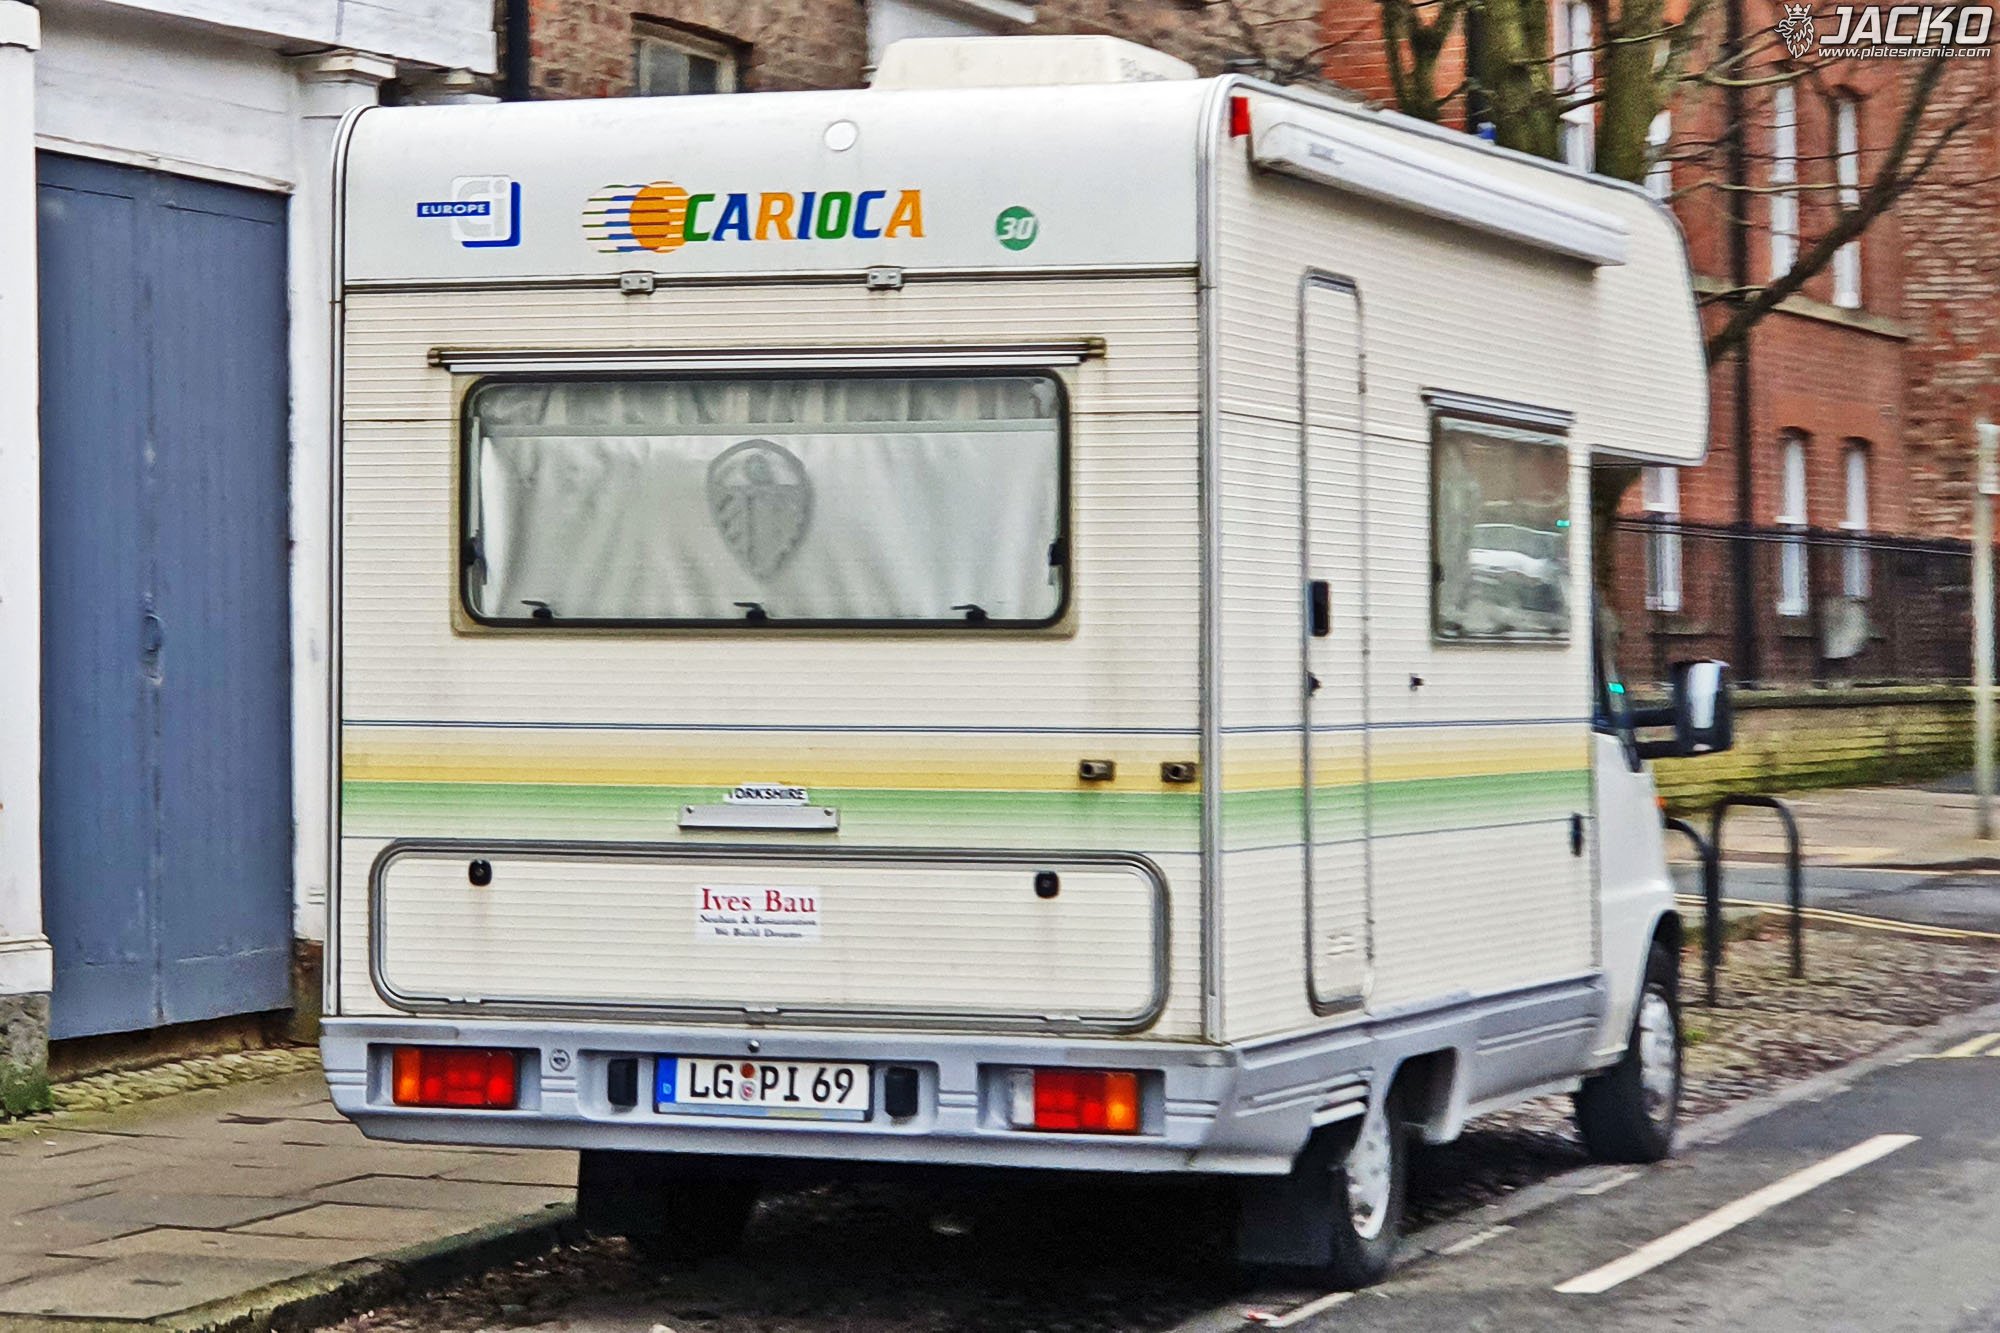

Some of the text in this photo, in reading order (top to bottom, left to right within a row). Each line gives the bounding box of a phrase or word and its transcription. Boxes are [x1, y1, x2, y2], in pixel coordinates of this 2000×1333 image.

[421, 203, 487, 215] EUROPE
[683, 189, 926, 242] CARIOCA
[998, 216, 1035, 240] 30
[702, 887, 817, 913] Ives Bau
[690, 1062, 855, 1104] LG PI 69
